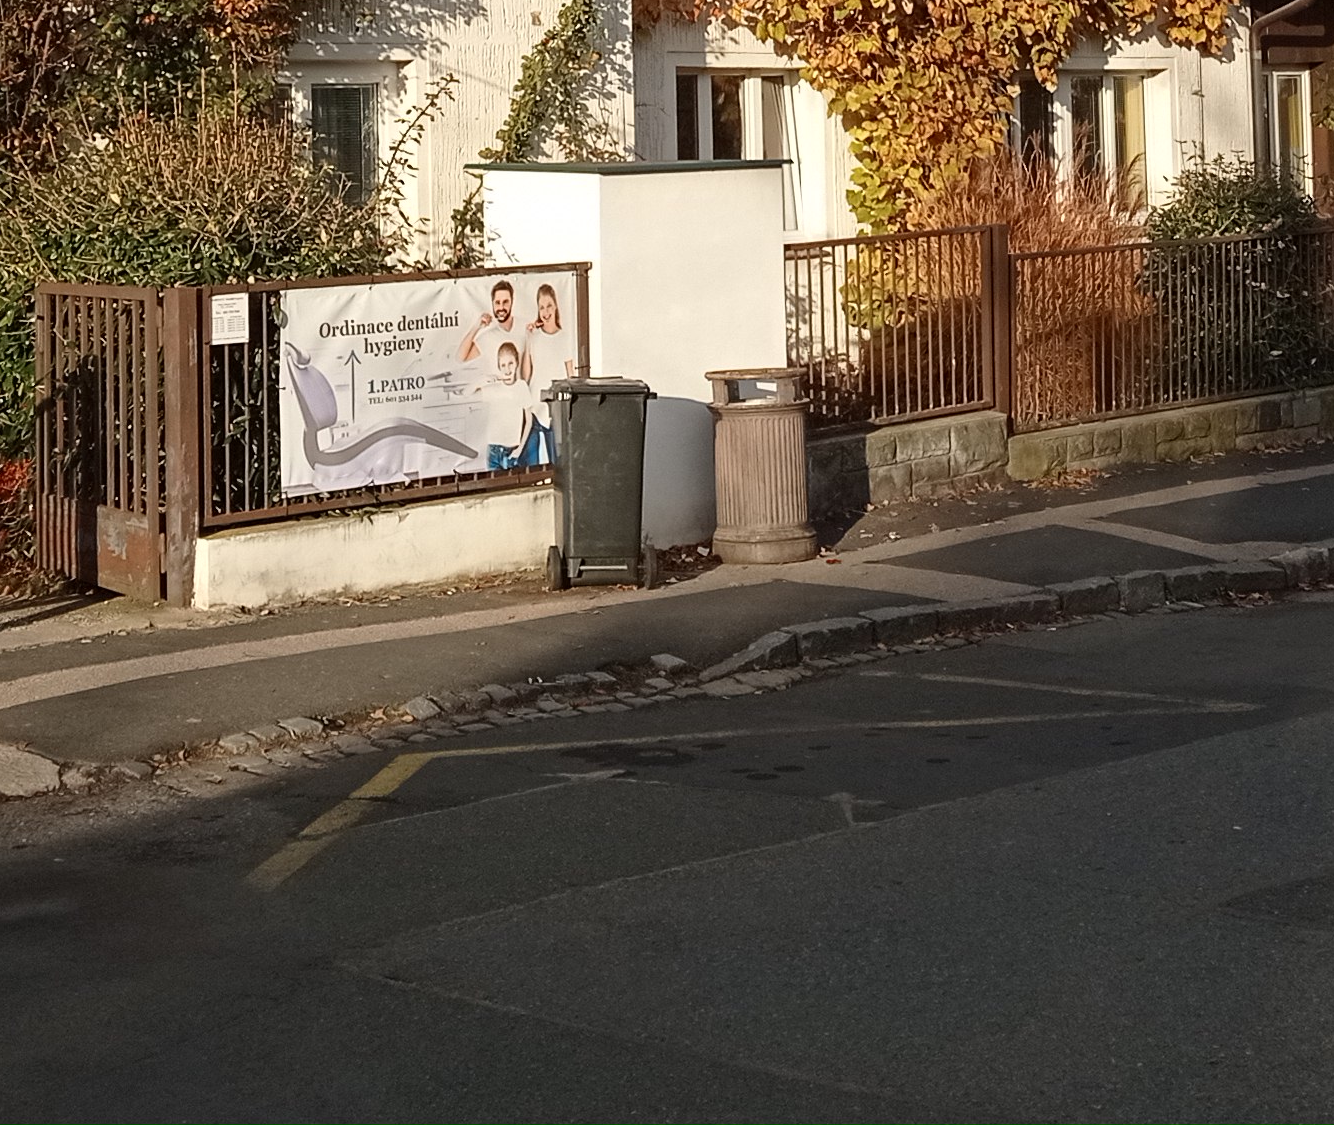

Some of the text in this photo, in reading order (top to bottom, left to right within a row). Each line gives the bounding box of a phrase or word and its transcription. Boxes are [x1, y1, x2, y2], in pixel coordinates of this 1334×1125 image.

[319, 310, 459, 338] Ordinace dentální
[363, 335, 425, 357] hygieny
[367, 376, 425, 394] 1.PATRO
